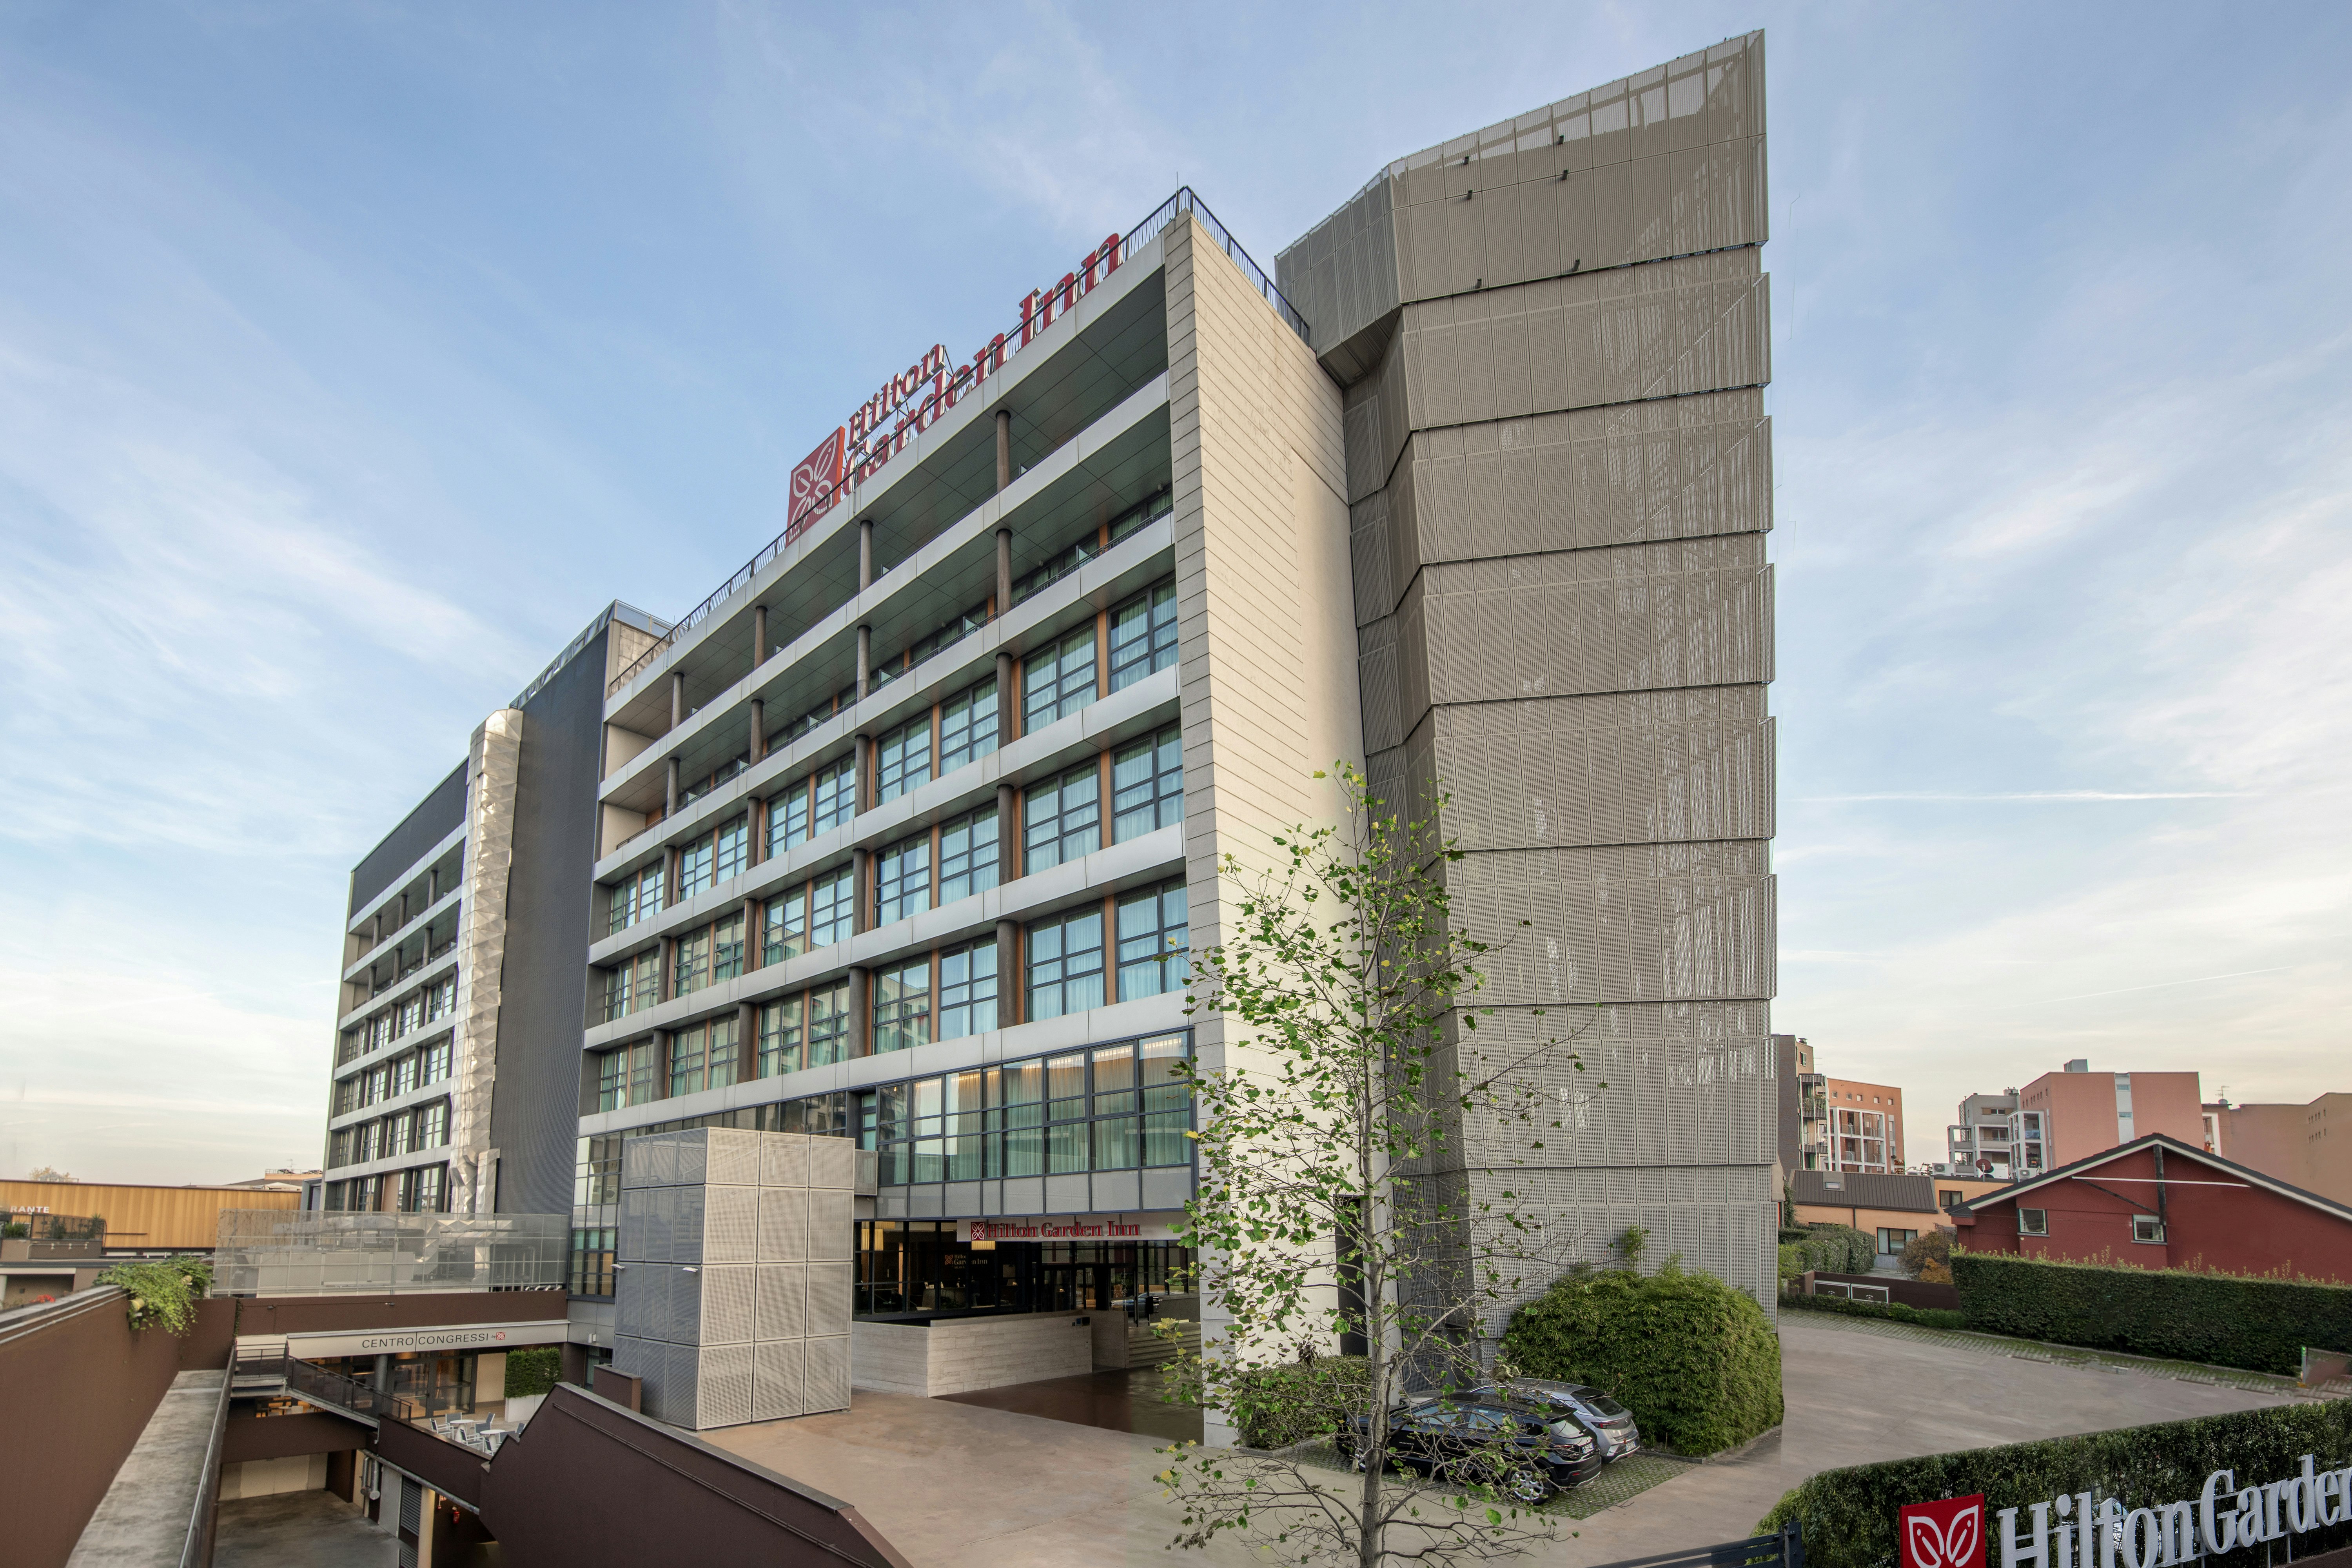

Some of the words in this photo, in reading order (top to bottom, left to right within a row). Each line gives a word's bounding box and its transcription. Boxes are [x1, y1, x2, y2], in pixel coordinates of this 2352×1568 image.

[842, 333, 1007, 496] Garden
[1016, 232, 1123, 353] Inn
[846, 343, 946, 452] Hilton
[987, 1222, 1038, 1238] Hilton
[1041, 1221, 1103, 1238] Garden
[1107, 1220, 1142, 1236] Inn
[362, 1337, 414, 1348] CENTRO
[418, 1333, 488, 1345] CONGRESSI
[1996, 1492, 2196, 1568] Hilton
